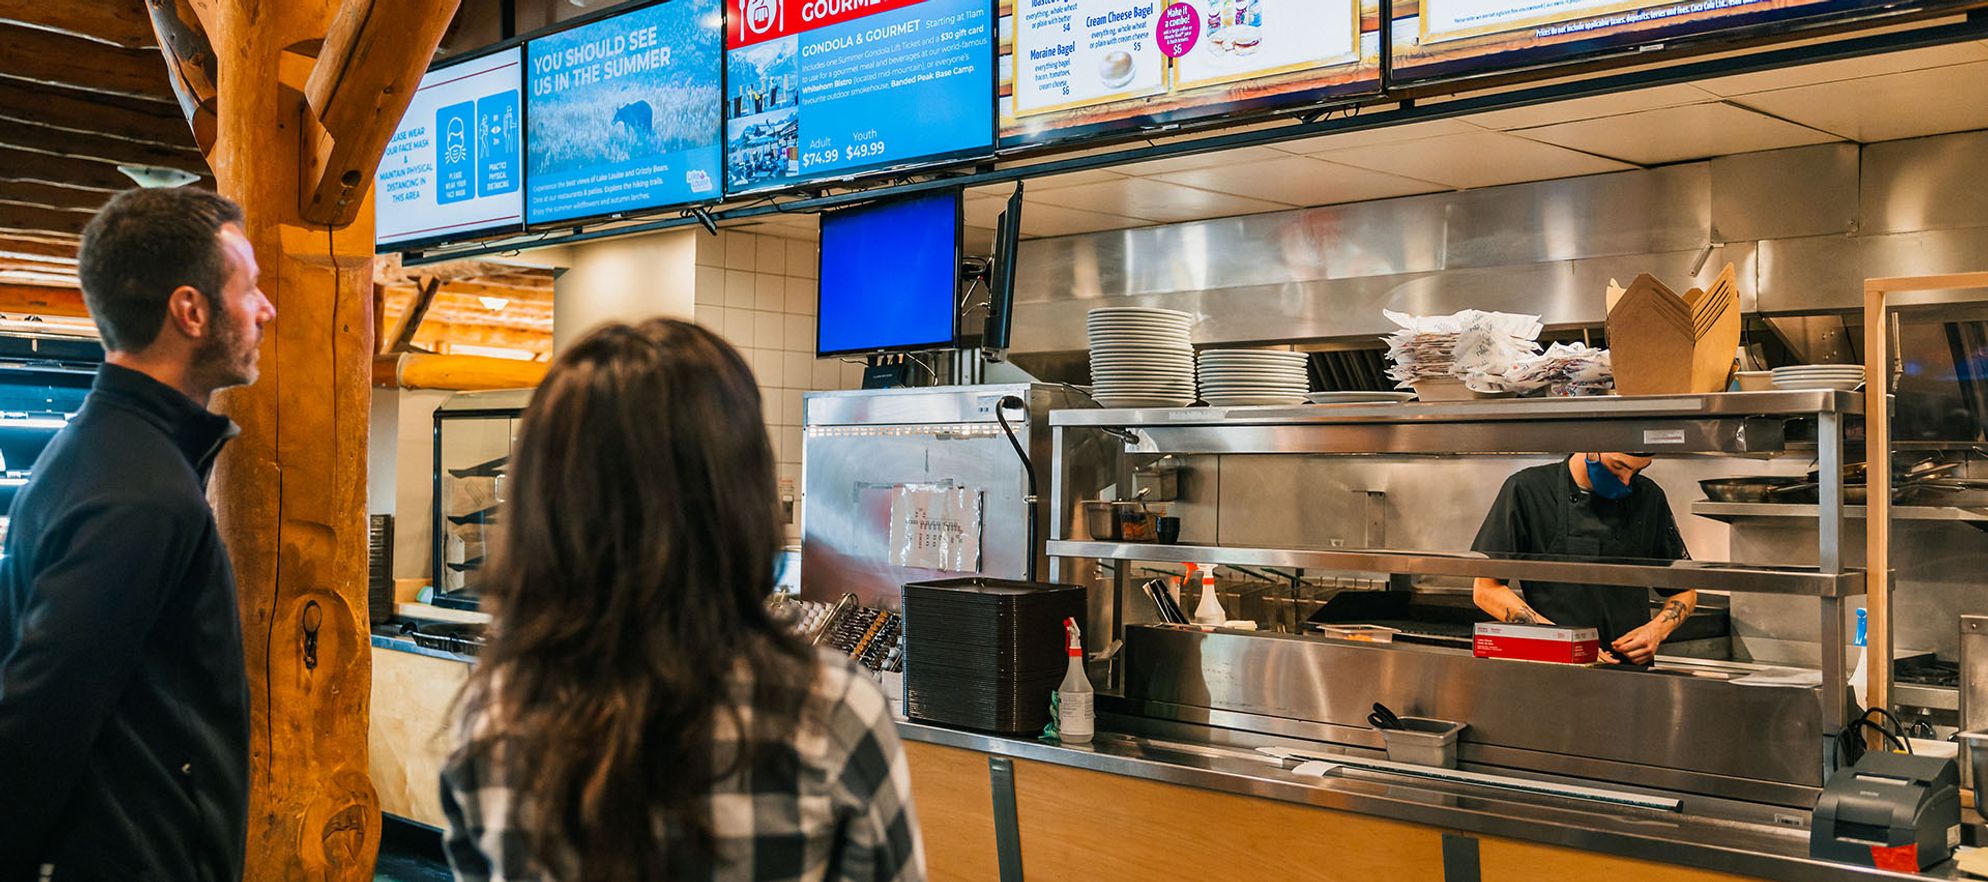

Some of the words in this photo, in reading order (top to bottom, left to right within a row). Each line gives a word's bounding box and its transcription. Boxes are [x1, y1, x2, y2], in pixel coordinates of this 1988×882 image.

[802, 0, 896, 22] GOUR
[926, 16, 955, 29] Starting
[957, 13, 964, 21] at
[966, 9, 984, 19] 11am
[1086, 16, 1106, 28] Cream
[1108, 10, 1132, 23] Cheese
[1133, 2, 1153, 19] Bagel
[1167, 7, 1182, 18] Make
[1182, 5, 1188, 15] it
[1063, 23, 1071, 32] $4
[1117, 24, 1131, 33] whole
[1132, 21, 1147, 30] wheat
[1165, 20, 1169, 28] a
[1170, 14, 1190, 26] combo!
[1536, 28, 1551, 37] Prices
[1558, 25, 1566, 34] not
[1567, 22, 1584, 32] include
[1585, 17, 1609, 31] applicable
[802, 36, 851, 57] GONDOLA
[856, 33, 863, 45] &
[865, 19, 921, 42] GOURMET
[1095, 40, 1106, 49] plain
[1118, 35, 1132, 43] cream
[1132, 32, 1149, 41] cheese
[1133, 42, 1142, 51] $5
[534, 51, 562, 75] YOU
[565, 35, 626, 67] SHOULD
[629, 25, 657, 51] SEE
[802, 62, 826, 72] Includes
[826, 58, 837, 66] one
[838, 53, 864, 64] Summer
[864, 46, 890, 57] Gondola
[902, 39, 921, 49] Ticket
[922, 36, 934, 45] and
[940, 31, 953, 42] $30
[954, 28, 967, 40] gift
[967, 24, 984, 35] card
[833, 66, 859, 78] gourmet
[860, 61, 875, 71] meal
[876, 57, 887, 66] and
[888, 50, 921, 65] beverages
[929, 47, 940, 56] our
[942, 37, 988, 53] world-famous
[1030, 46, 1056, 60] Moraine
[1057, 41, 1076, 56] Bagel
[1173, 44, 1183, 56] $6
[534, 76, 552, 96] US
[555, 71, 569, 92] IN
[573, 64, 600, 86] THE
[603, 46, 671, 80] SUMMER
[802, 82, 833, 94] Whitehorn
[834, 78, 853, 88] Bistro
[927, 60, 934, 68] or
[802, 94, 826, 105] favourite
[827, 90, 850, 100] outdoor
[891, 75, 916, 88] Banded
[917, 71, 934, 82] Peak
[935, 69, 952, 79] Base
[1062, 86, 1070, 95] $6
[391, 128, 408, 142] EASE
[408, 126, 425, 139] WEAR
[810, 137, 831, 149] Adult
[852, 129, 878, 142] Youth
[386, 145, 398, 156] OUR
[399, 141, 412, 153] FACE
[413, 138, 429, 150] MASK
[802, 149, 838, 167] $74.99
[846, 141, 885, 160] $49.99
[380, 168, 405, 181] MAINTAIN
[406, 162, 433, 175] PHYSICAL
[566, 179, 576, 188] best
[577, 177, 590, 185] views
[596, 174, 607, 182] Lake
[608, 171, 624, 180] Louise
[625, 168, 635, 177] and
[635, 166, 652, 176] Grizzly
[387, 178, 419, 192] DISTANCING
[420, 176, 426, 186] IN
[558, 190, 583, 200] restaurants
[604, 184, 622, 193] Explore
[623, 181, 632, 190] the
[633, 179, 649, 189] hiking
[393, 193, 404, 203] THIS
[405, 190, 420, 201] AREA
[601, 197, 610, 206] and
